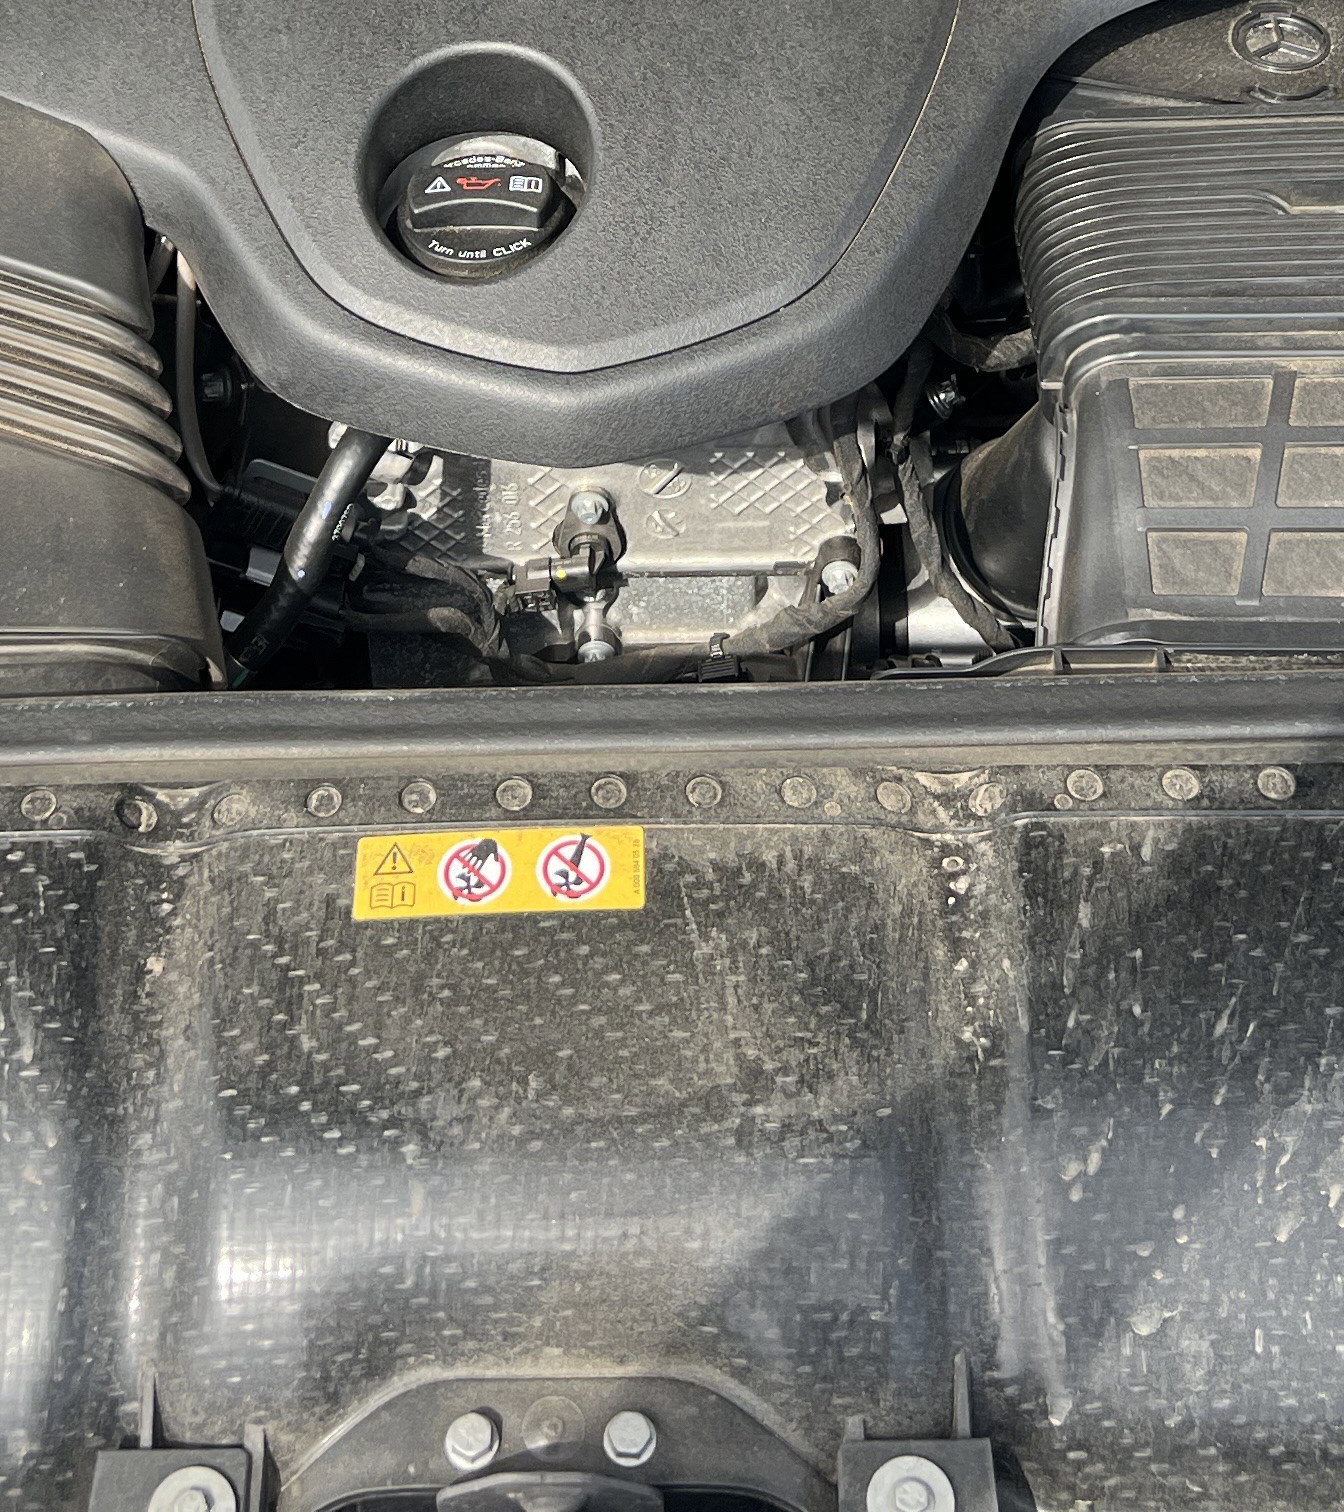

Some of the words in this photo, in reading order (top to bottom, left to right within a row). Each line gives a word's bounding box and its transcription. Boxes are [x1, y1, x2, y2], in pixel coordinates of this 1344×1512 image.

[428, 239, 455, 256] Turn
[458, 249, 487, 259] until
[492, 238, 532, 258] CLICK
